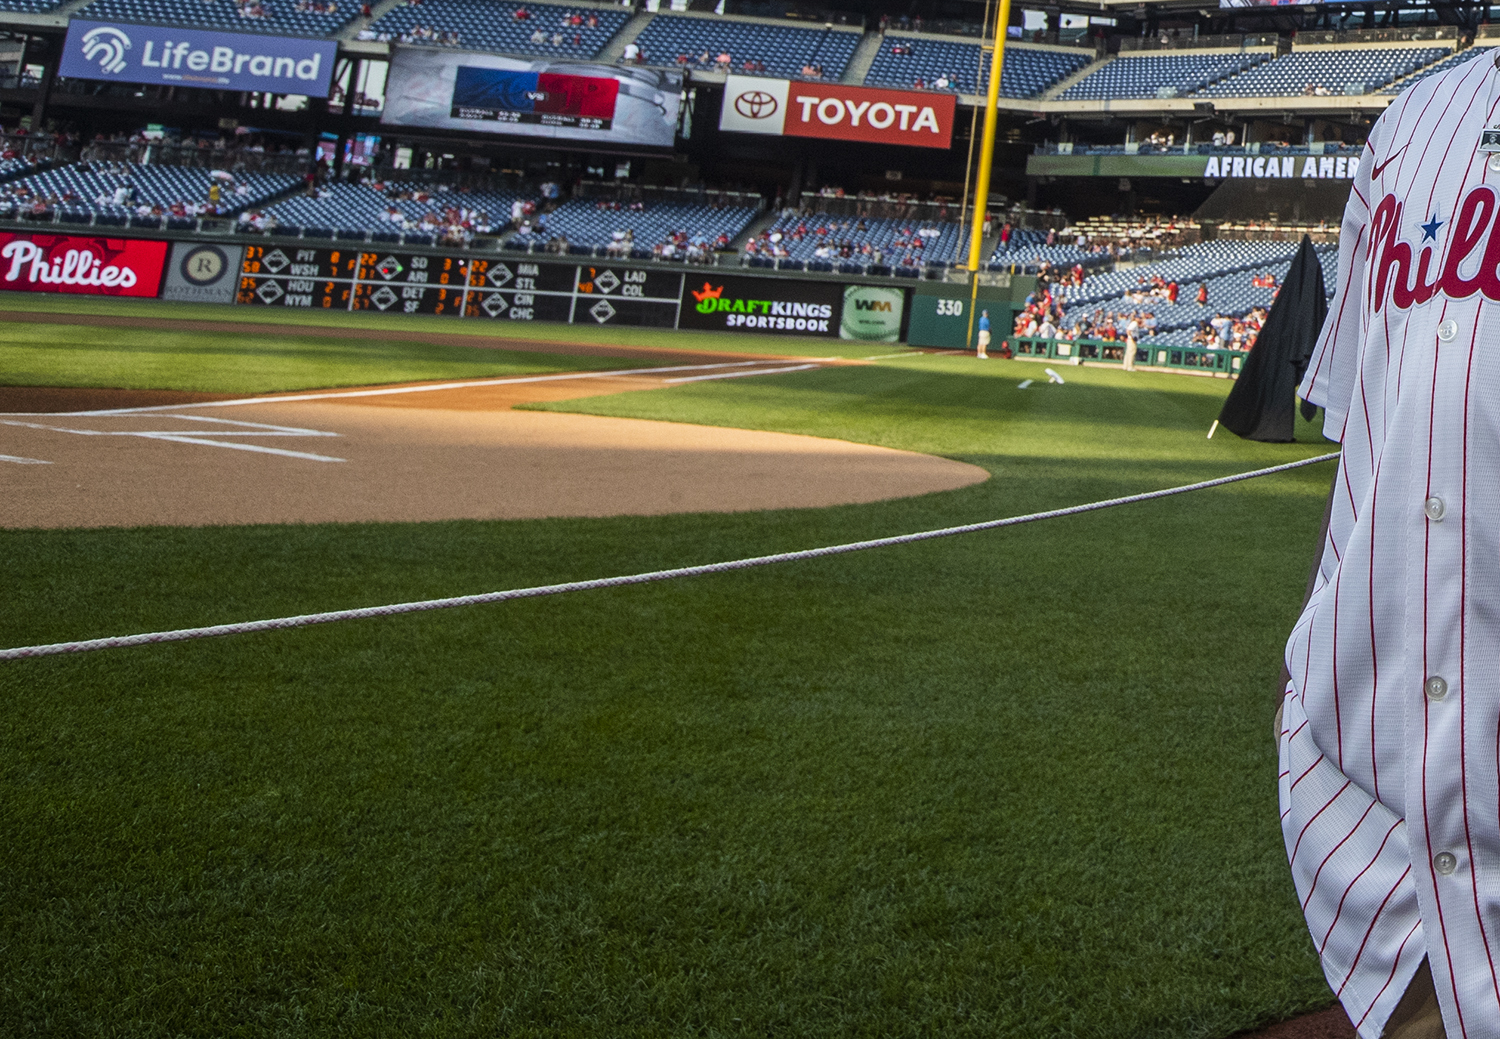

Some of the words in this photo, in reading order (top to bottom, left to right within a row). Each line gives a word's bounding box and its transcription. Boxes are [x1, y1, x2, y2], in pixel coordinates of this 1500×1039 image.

[141, 40, 322, 80] LifeBrand
[797, 95, 940, 133] TOYOTA
[1204, 156, 1295, 178] AFRICAN
[296, 250, 316, 262] PIT
[1, 240, 137, 288] Phillies
[197, 257, 213, 273] R
[290, 263, 319, 276] WSH
[411, 257, 428, 269] SD
[406, 271, 428, 283] ARI
[624, 270, 647, 283] LAD
[287, 281, 315, 292] HOU
[516, 277, 536, 290] STL
[402, 286, 425, 299] DET
[622, 284, 644, 297] COL
[284, 294, 313, 307] NYM
[514, 293, 534, 306] CIN
[855, 299, 892, 312] WM
[403, 301, 419, 313] SF
[509, 307, 534, 320] CHC
[936, 299, 963, 316] 330
[726, 314, 829, 332] SPORTSBOOK
